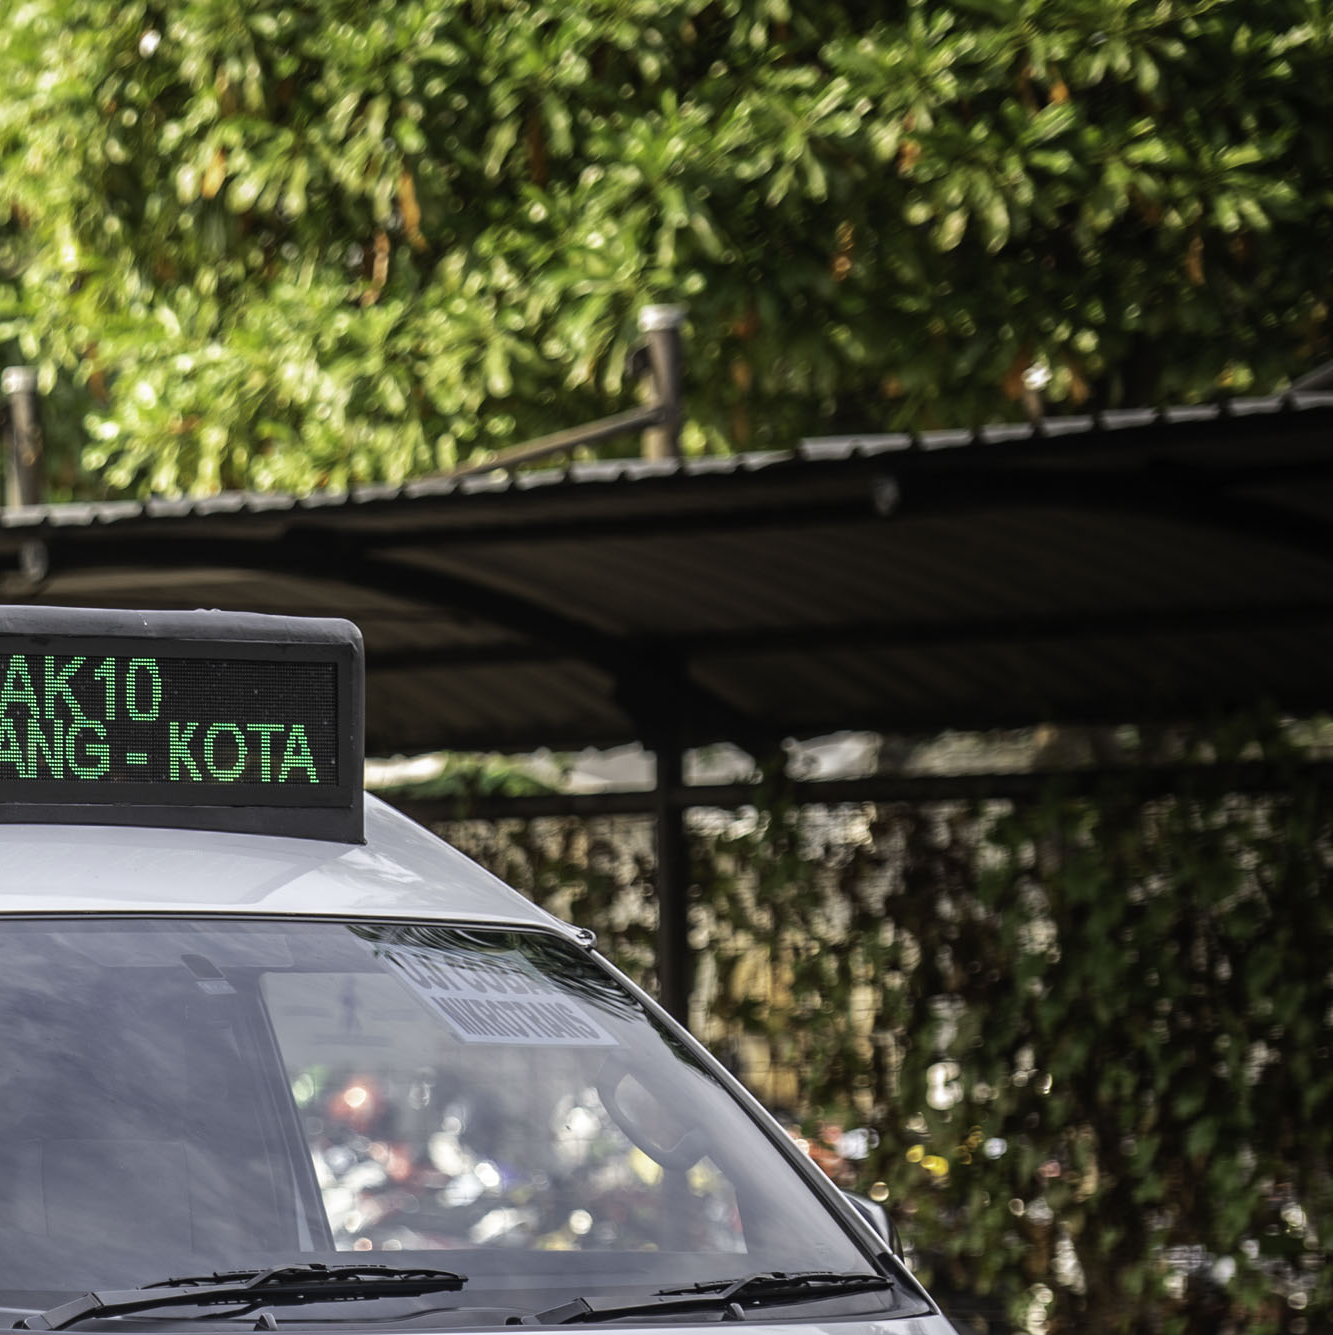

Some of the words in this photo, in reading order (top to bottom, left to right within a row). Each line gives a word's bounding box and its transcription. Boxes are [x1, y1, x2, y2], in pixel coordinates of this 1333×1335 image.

[126, 752, 148, 765] -
[169, 721, 320, 783] KOTA
[429, 996, 601, 1040] MIKROTRANS
